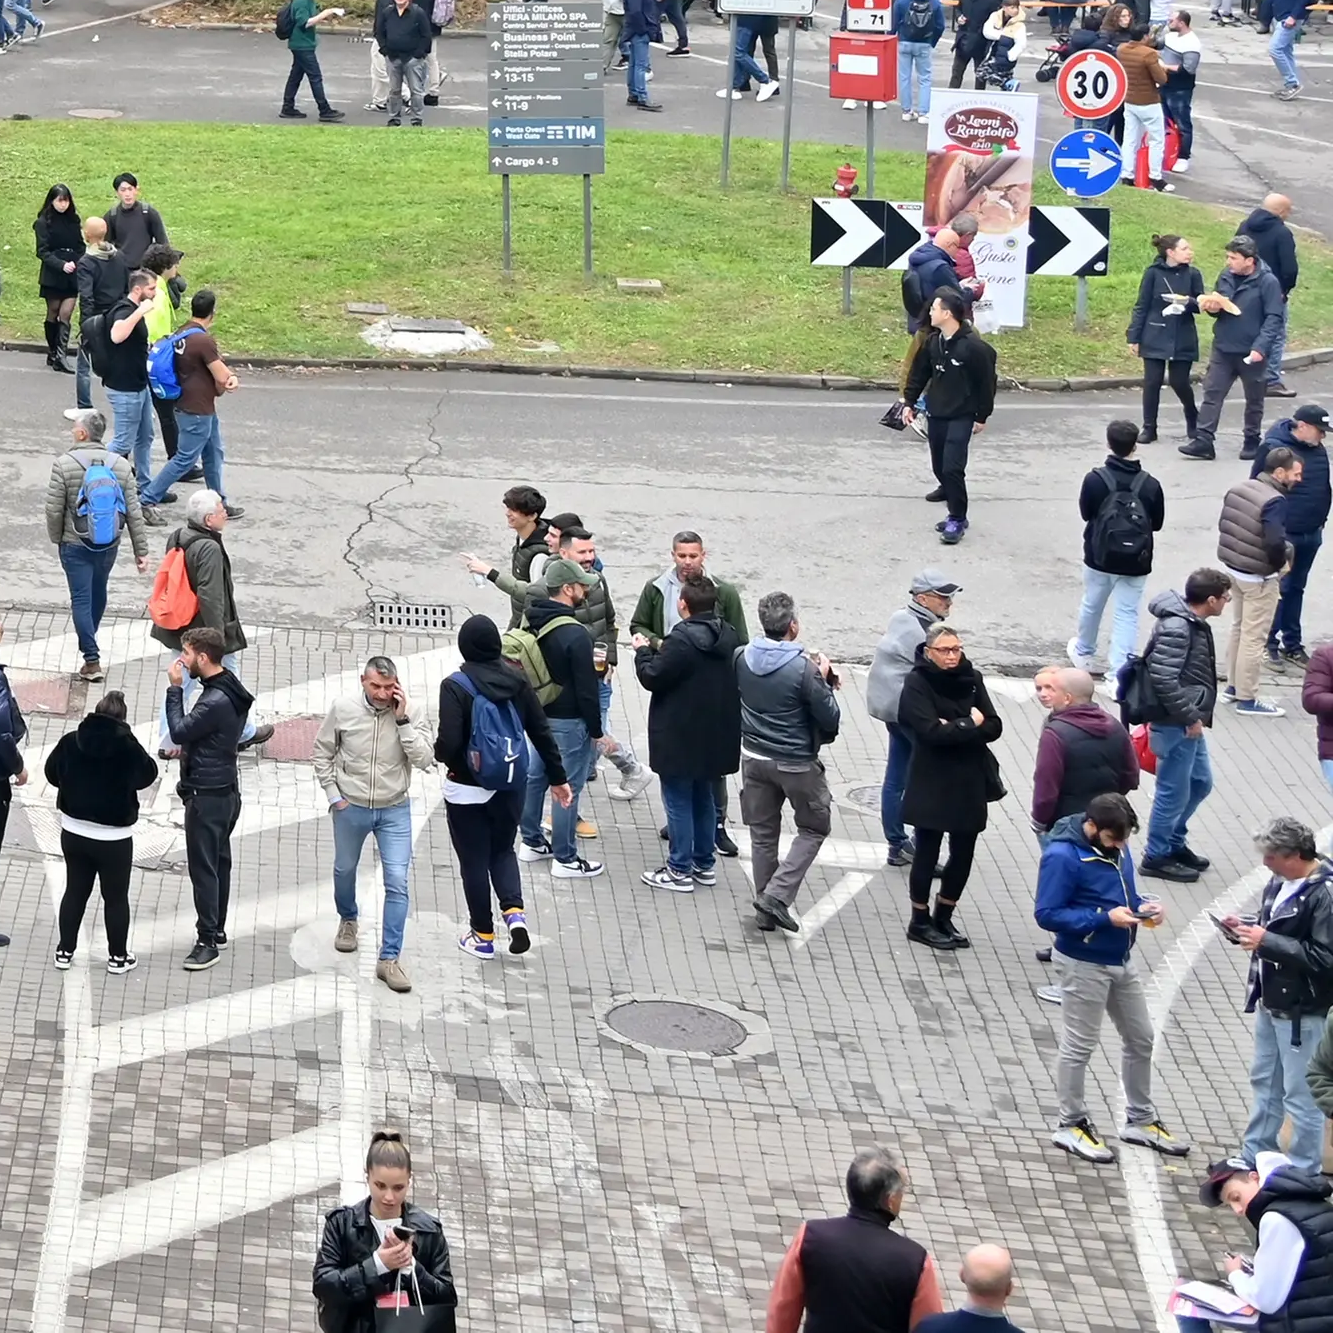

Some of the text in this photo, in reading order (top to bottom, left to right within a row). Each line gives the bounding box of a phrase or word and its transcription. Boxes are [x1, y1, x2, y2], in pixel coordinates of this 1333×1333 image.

[532, 5, 563, 13] Offices
[502, 13, 588, 21] FIERA MILANO SPA
[870, 14, 884, 25] 71
[503, 32, 576, 42] Business Point
[504, 49, 558, 58] Stella Polare
[504, 73, 534, 82] 13-15
[1073, 70, 1109, 100] 30
[505, 101, 529, 111] 11-9
[966, 115, 1001, 128] Leoni
[565, 125, 596, 140] TIM
[956, 124, 1014, 139] Randolfo
[504, 156, 559, 168] Cargo 4 5
[973, 241, 1016, 265] Gusto
